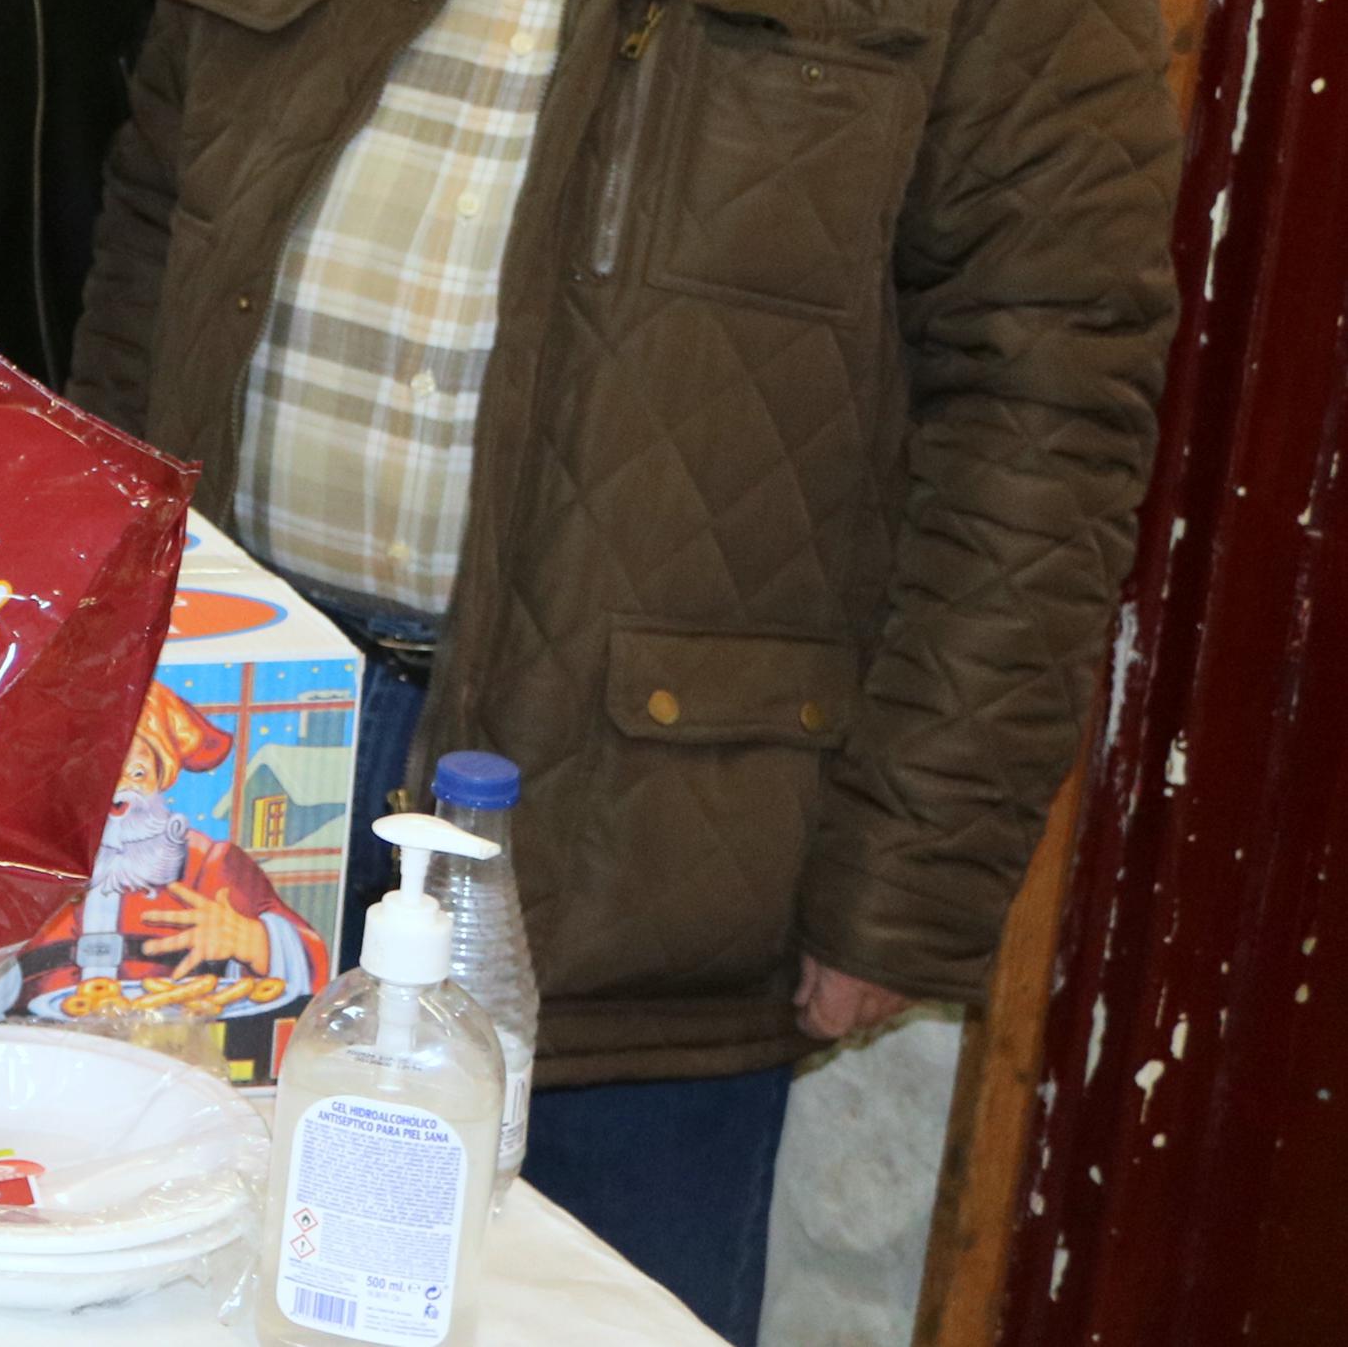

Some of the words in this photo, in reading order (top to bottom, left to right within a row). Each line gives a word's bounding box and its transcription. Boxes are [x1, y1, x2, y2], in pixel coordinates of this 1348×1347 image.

[331, 1101, 347, 1116] GEL
[376, 1123, 401, 1137] PARA
[402, 1128, 422, 1141] PIEL
[424, 1131, 450, 1143] SANA
[366, 1275, 386, 1290] 500
